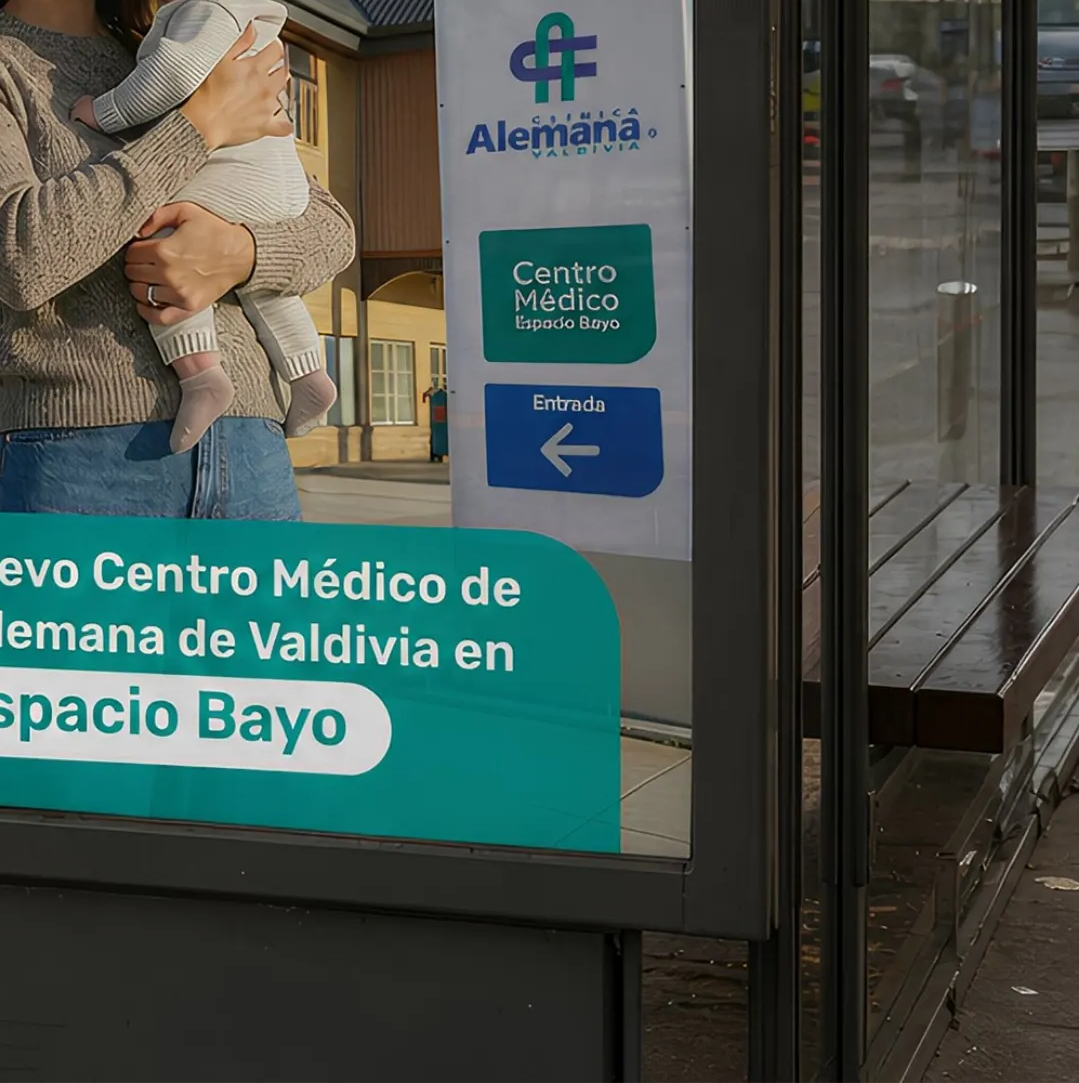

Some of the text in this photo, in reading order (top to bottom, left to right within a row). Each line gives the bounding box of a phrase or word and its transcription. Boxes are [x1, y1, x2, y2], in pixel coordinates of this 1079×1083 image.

[466, 117, 640, 154] Alemana
[531, 141, 640, 159] VALDIVIA
[513, 260, 618, 286] Centro
[515, 287, 620, 312] Médico
[533, 394, 606, 413] Entrada
[93, 551, 258, 596] Centro
[273, 558, 446, 604] Médico
[461, 567, 521, 607] de
[178, 618, 236, 658] de
[248, 621, 439, 668] Valdivia
[454, 639, 514, 672] en
[198, 690, 347, 756] Bayo
